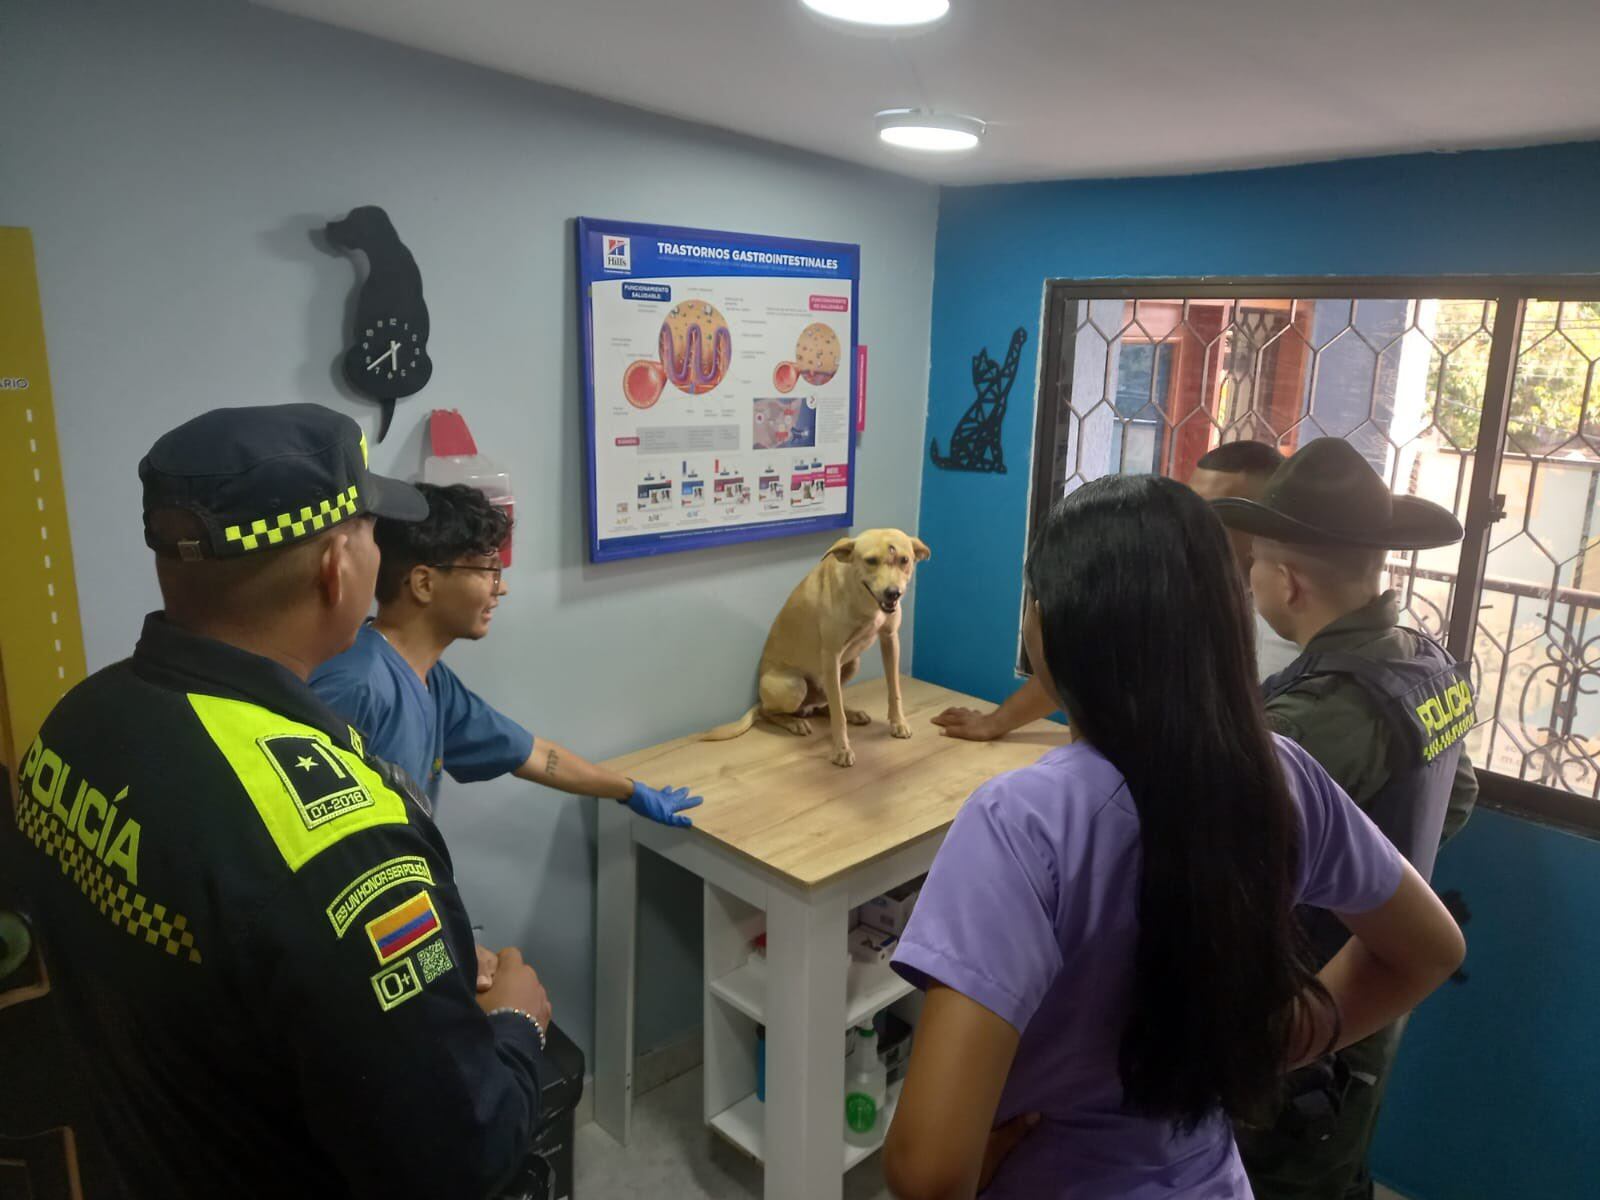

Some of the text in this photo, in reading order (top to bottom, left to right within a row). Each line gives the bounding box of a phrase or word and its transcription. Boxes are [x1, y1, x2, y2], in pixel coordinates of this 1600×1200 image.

[657, 242, 730, 260] TRASTORNOS
[732, 250, 838, 270] GASTROINTESTINALES
[18, 733, 141, 887] POLICÍA
[335, 905, 348, 925] ES
[345, 894, 360, 912] UN
[356, 871, 388, 901] HONOR
[386, 865, 405, 880] SER
